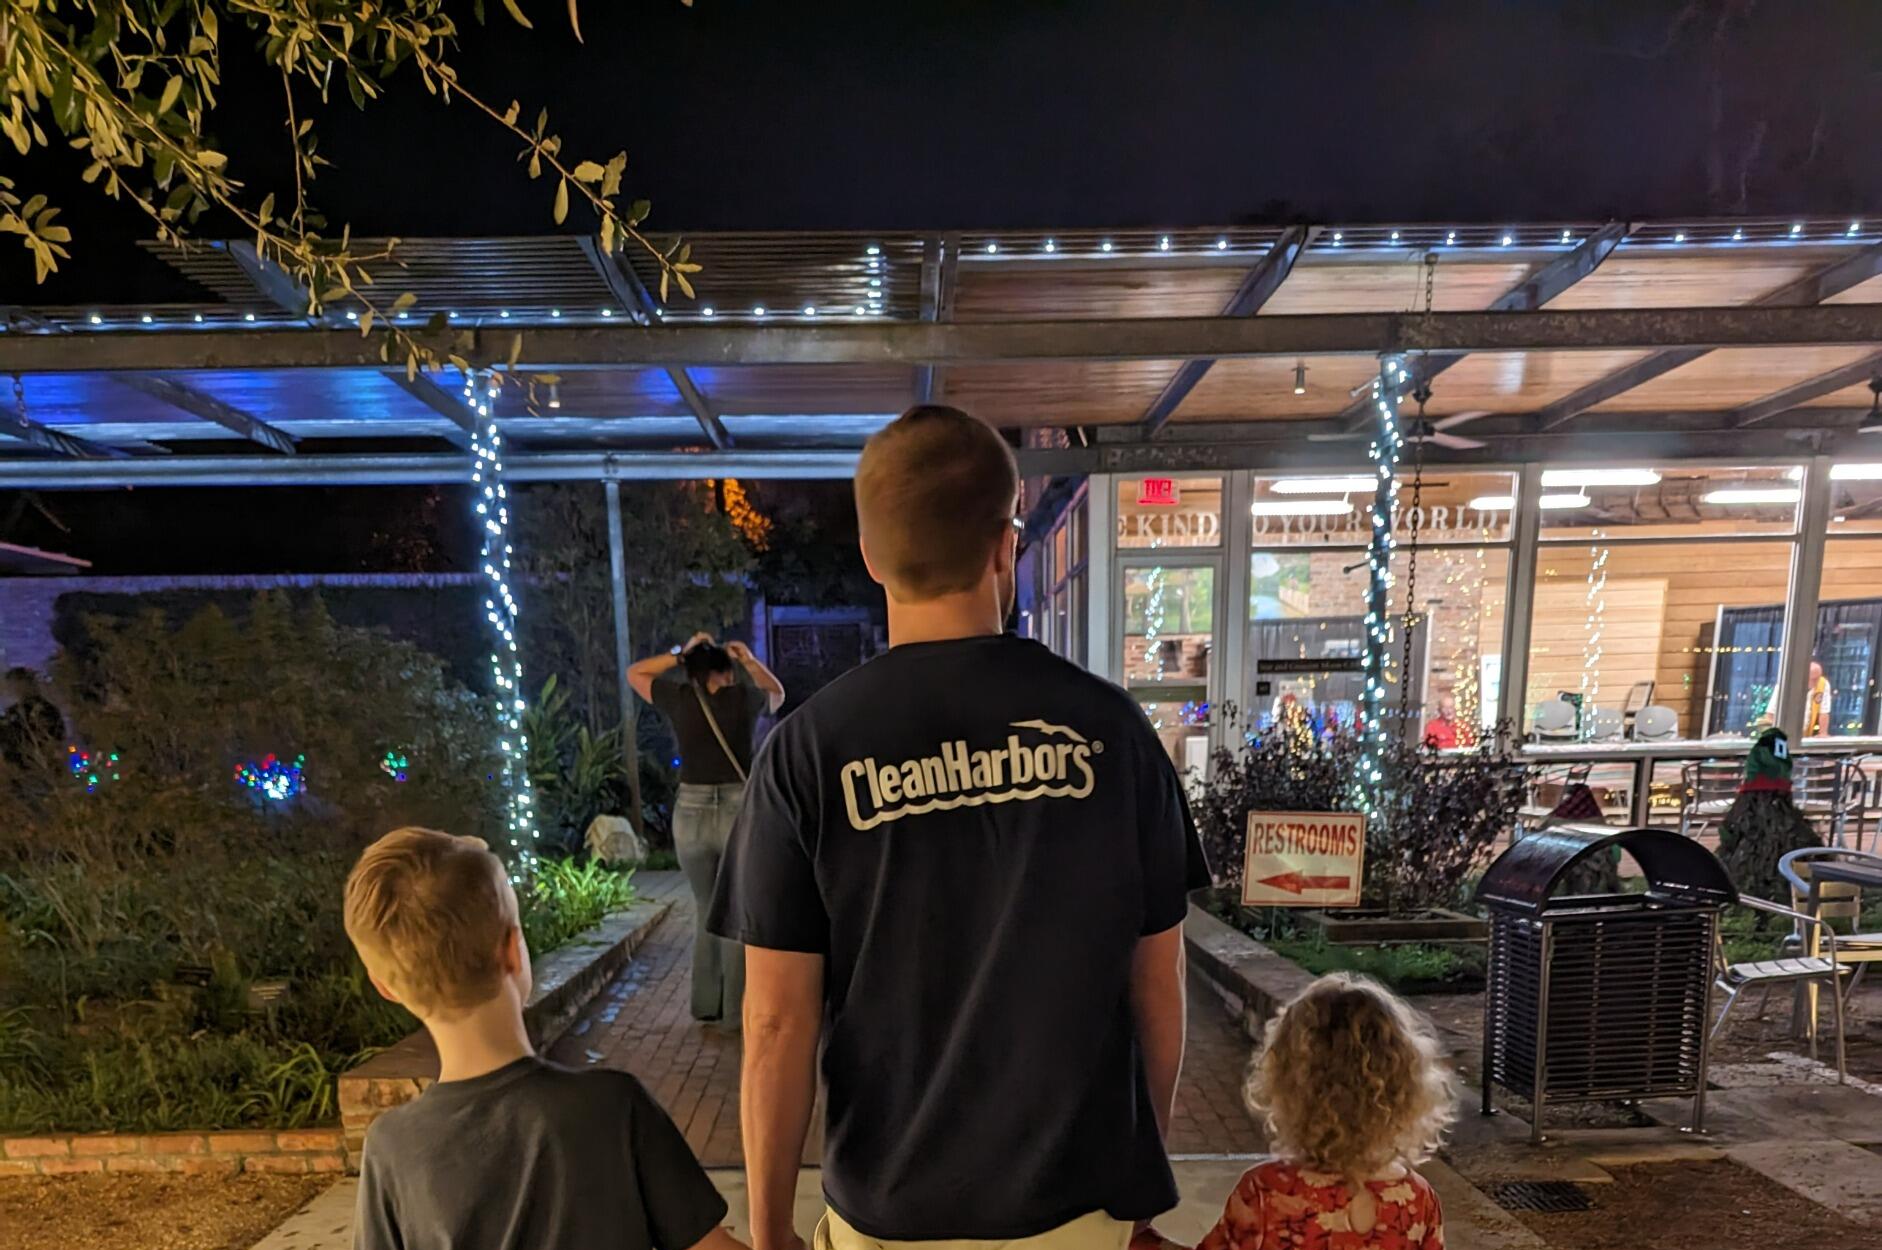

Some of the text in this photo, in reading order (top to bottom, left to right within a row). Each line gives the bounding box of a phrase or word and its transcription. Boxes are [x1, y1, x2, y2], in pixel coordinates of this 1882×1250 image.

[1136, 511, 1219, 538] KIND
[1281, 508, 1363, 534] YOUR
[1252, 822, 1358, 857] RESTROOMS
